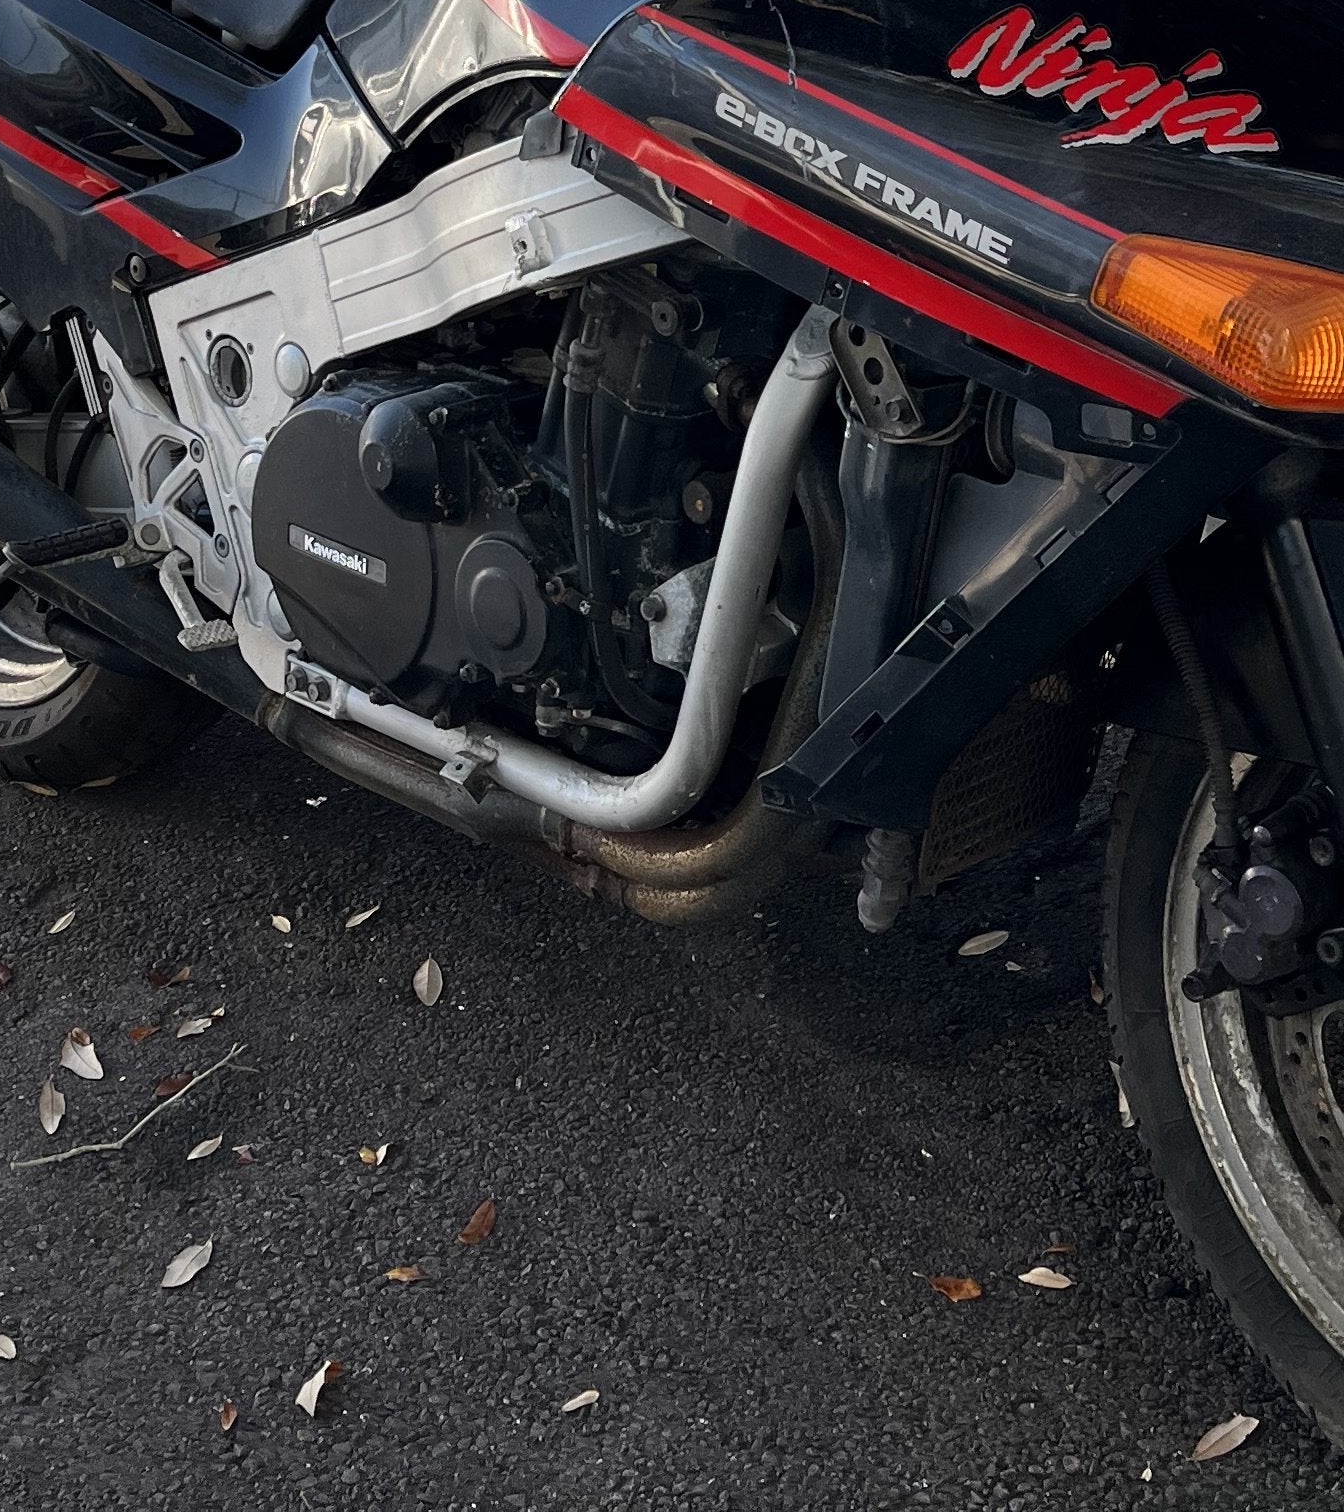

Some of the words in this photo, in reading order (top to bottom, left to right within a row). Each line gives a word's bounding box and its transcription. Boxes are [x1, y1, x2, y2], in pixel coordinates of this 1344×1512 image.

[947, 4, 1280, 153] Ninja
[853, 162, 1014, 264] FRAME
[304, 534, 367, 575] Kawasaki
